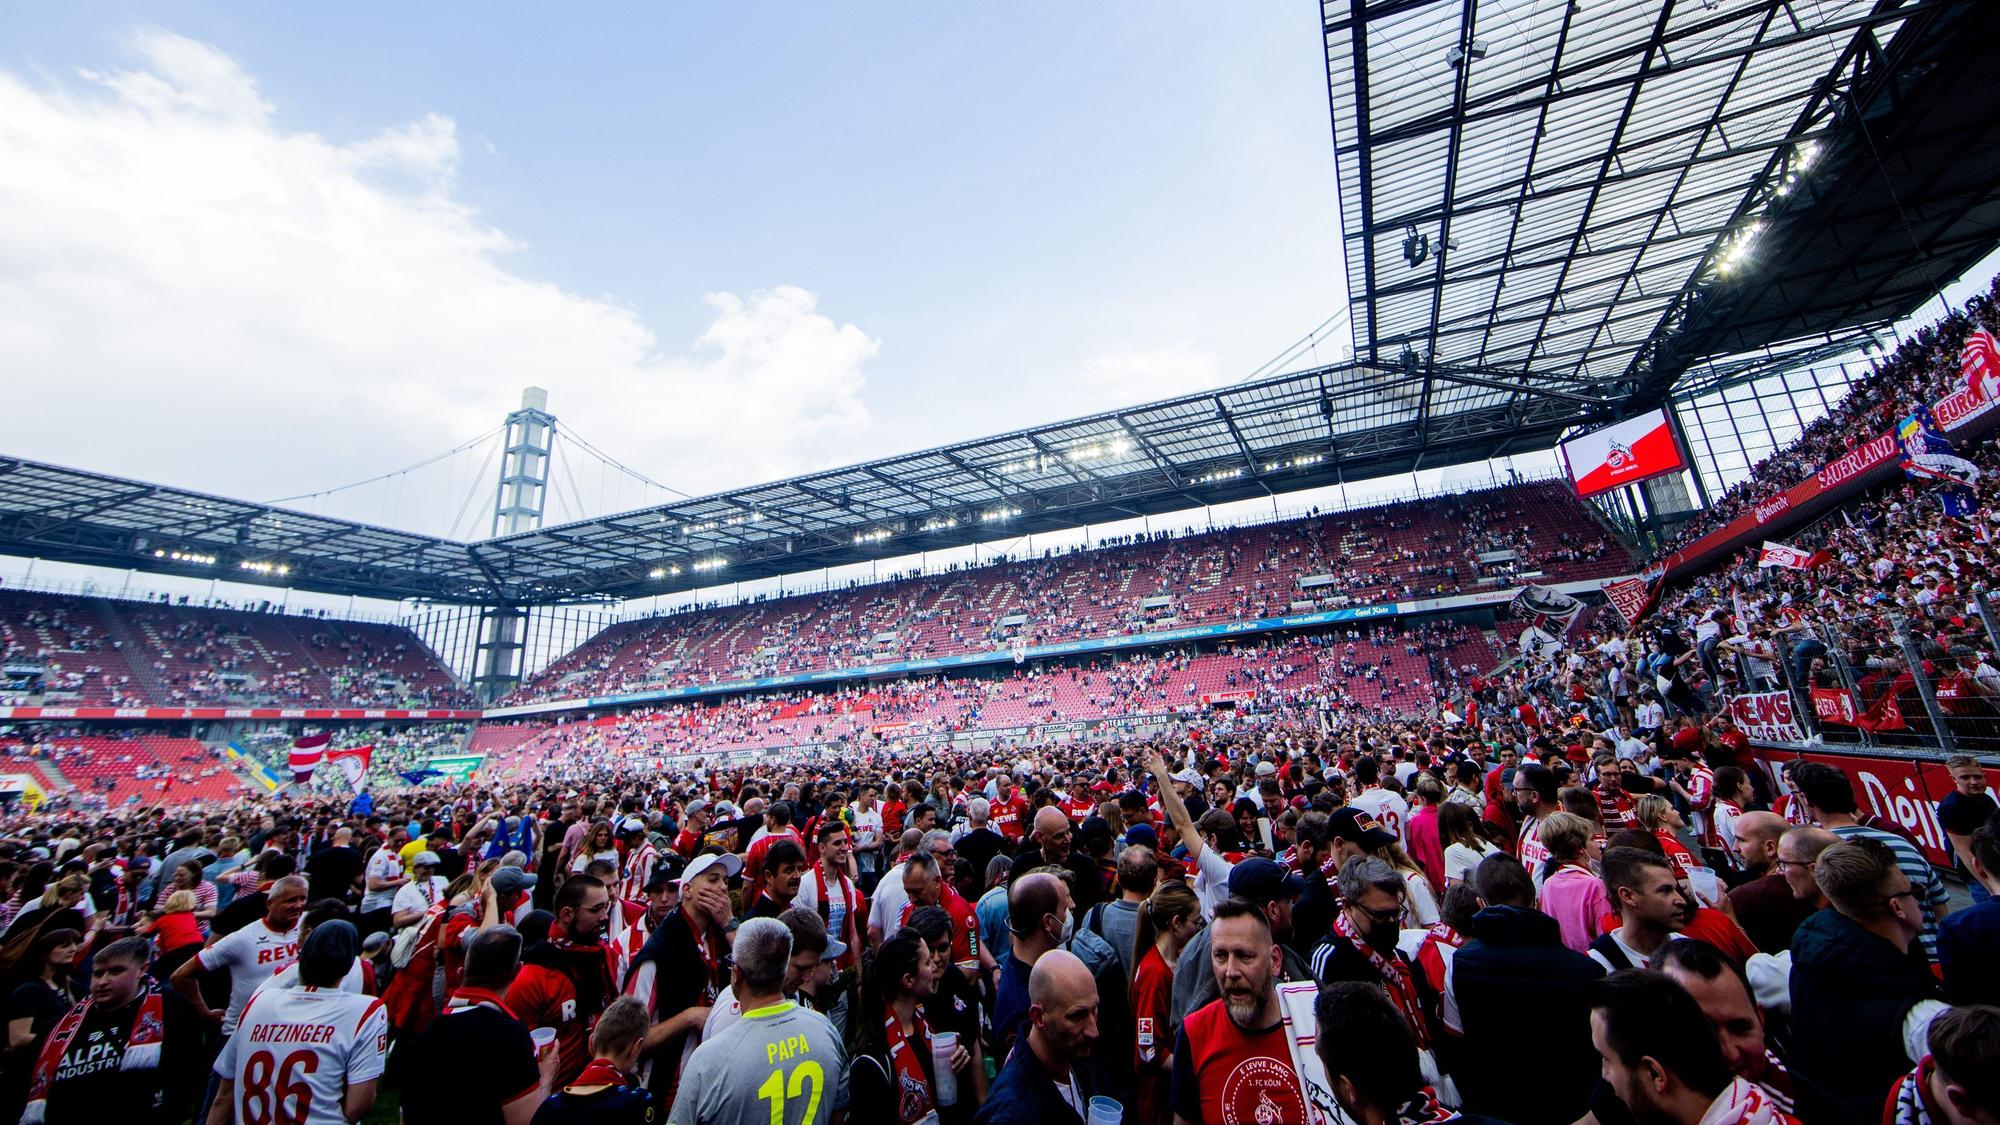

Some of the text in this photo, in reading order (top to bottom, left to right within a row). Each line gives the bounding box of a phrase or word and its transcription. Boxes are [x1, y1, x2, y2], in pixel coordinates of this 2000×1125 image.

[1937, 388, 1984, 424] EURO
[1817, 434, 1895, 488] SAUERLAND
[994, 812, 1017, 824] REWE
[1071, 808, 1089, 818] REW
[257, 942, 301, 964] REW
[967, 930, 977, 956] DEVK
[249, 1023, 336, 1044] RATZINGER
[766, 1033, 810, 1065] PAPA
[55, 1056, 121, 1081] NDUSTRI
[1239, 1060, 1289, 1078] E LEVVE LANG
[242, 1049, 319, 1125] 86
[757, 1060, 825, 1125] 12
[1255, 1079, 1263, 1087] FC
[1264, 1077, 1281, 1087] KÖLN
